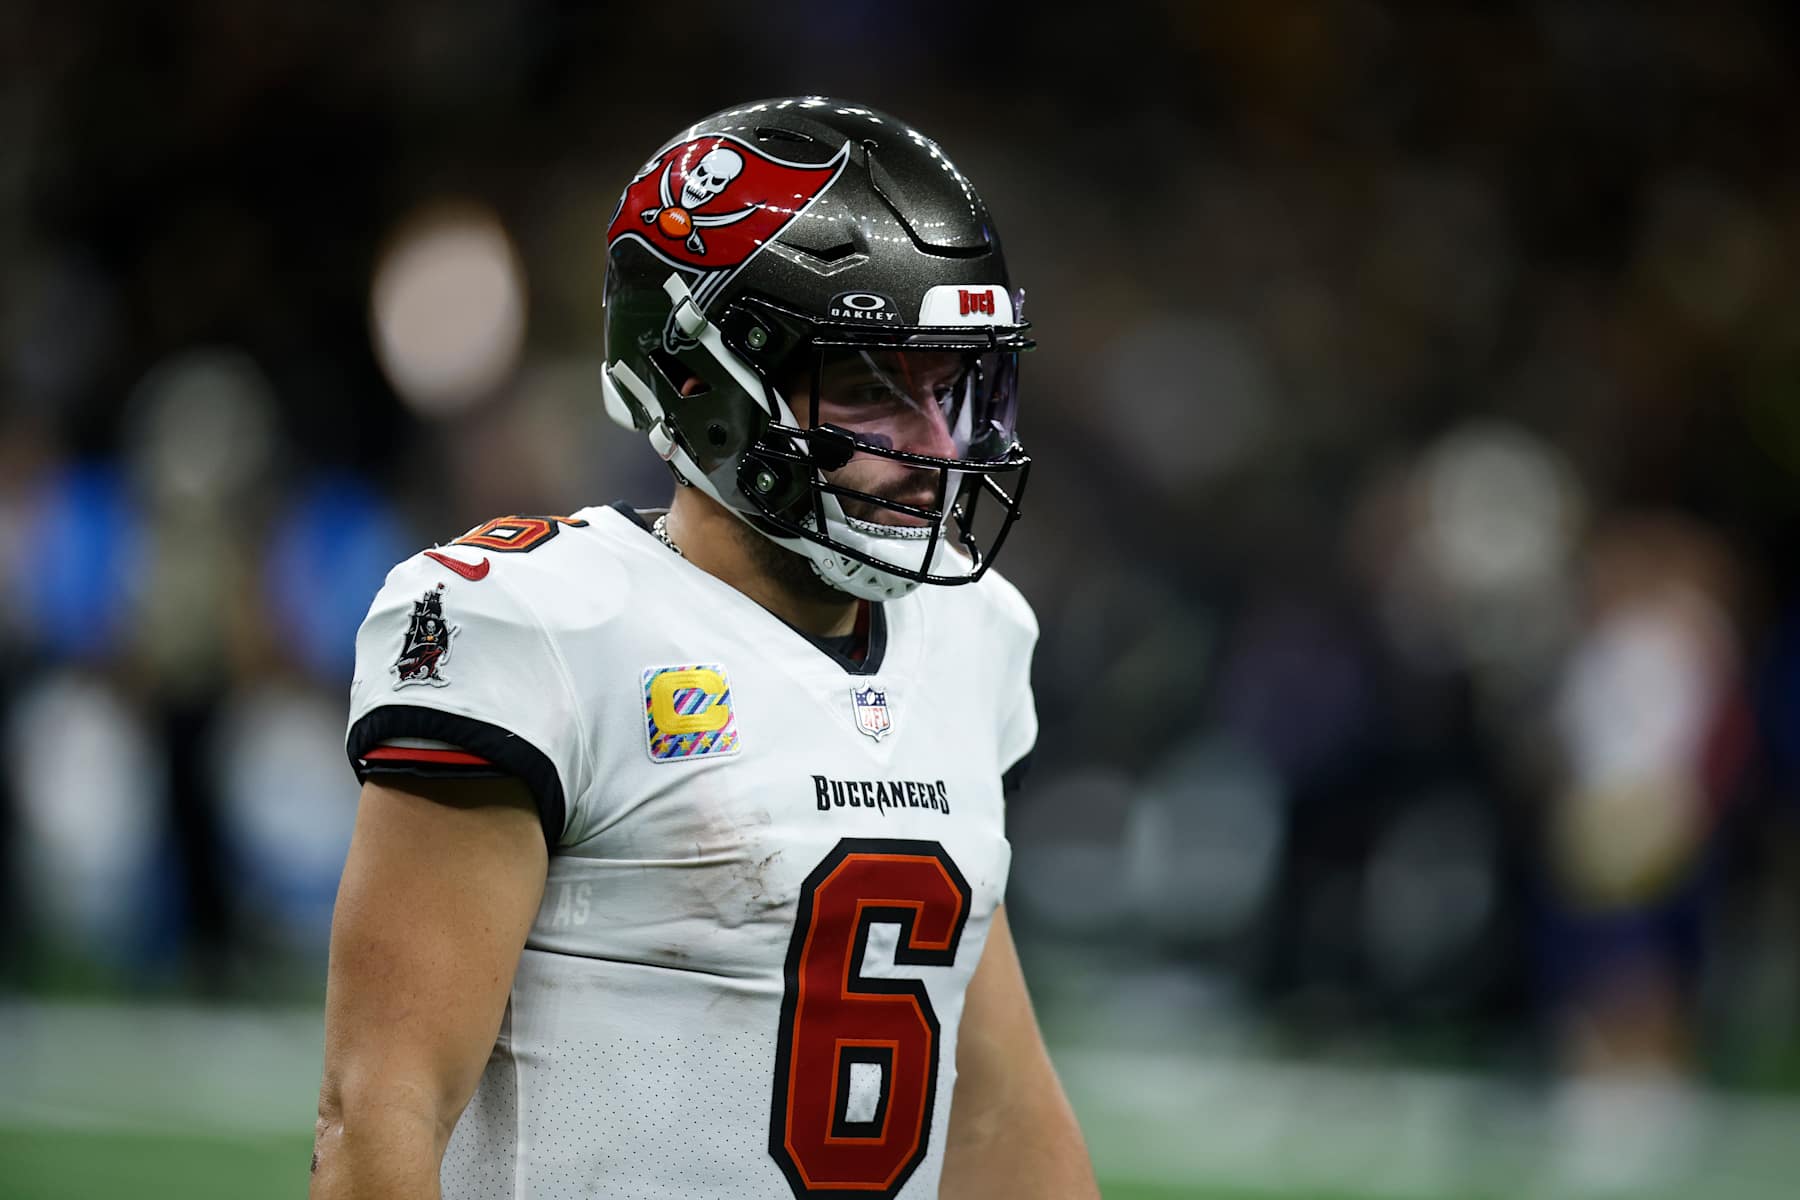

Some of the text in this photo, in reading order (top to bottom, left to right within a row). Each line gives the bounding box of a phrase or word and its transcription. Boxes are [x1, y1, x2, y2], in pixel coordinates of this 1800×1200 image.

[831, 308, 896, 321] OAKLEY
[650, 669, 730, 735] C
[862, 707, 889, 730] NFL
[811, 775, 950, 817] BUCCANEERS
[768, 837, 972, 1200] 6
